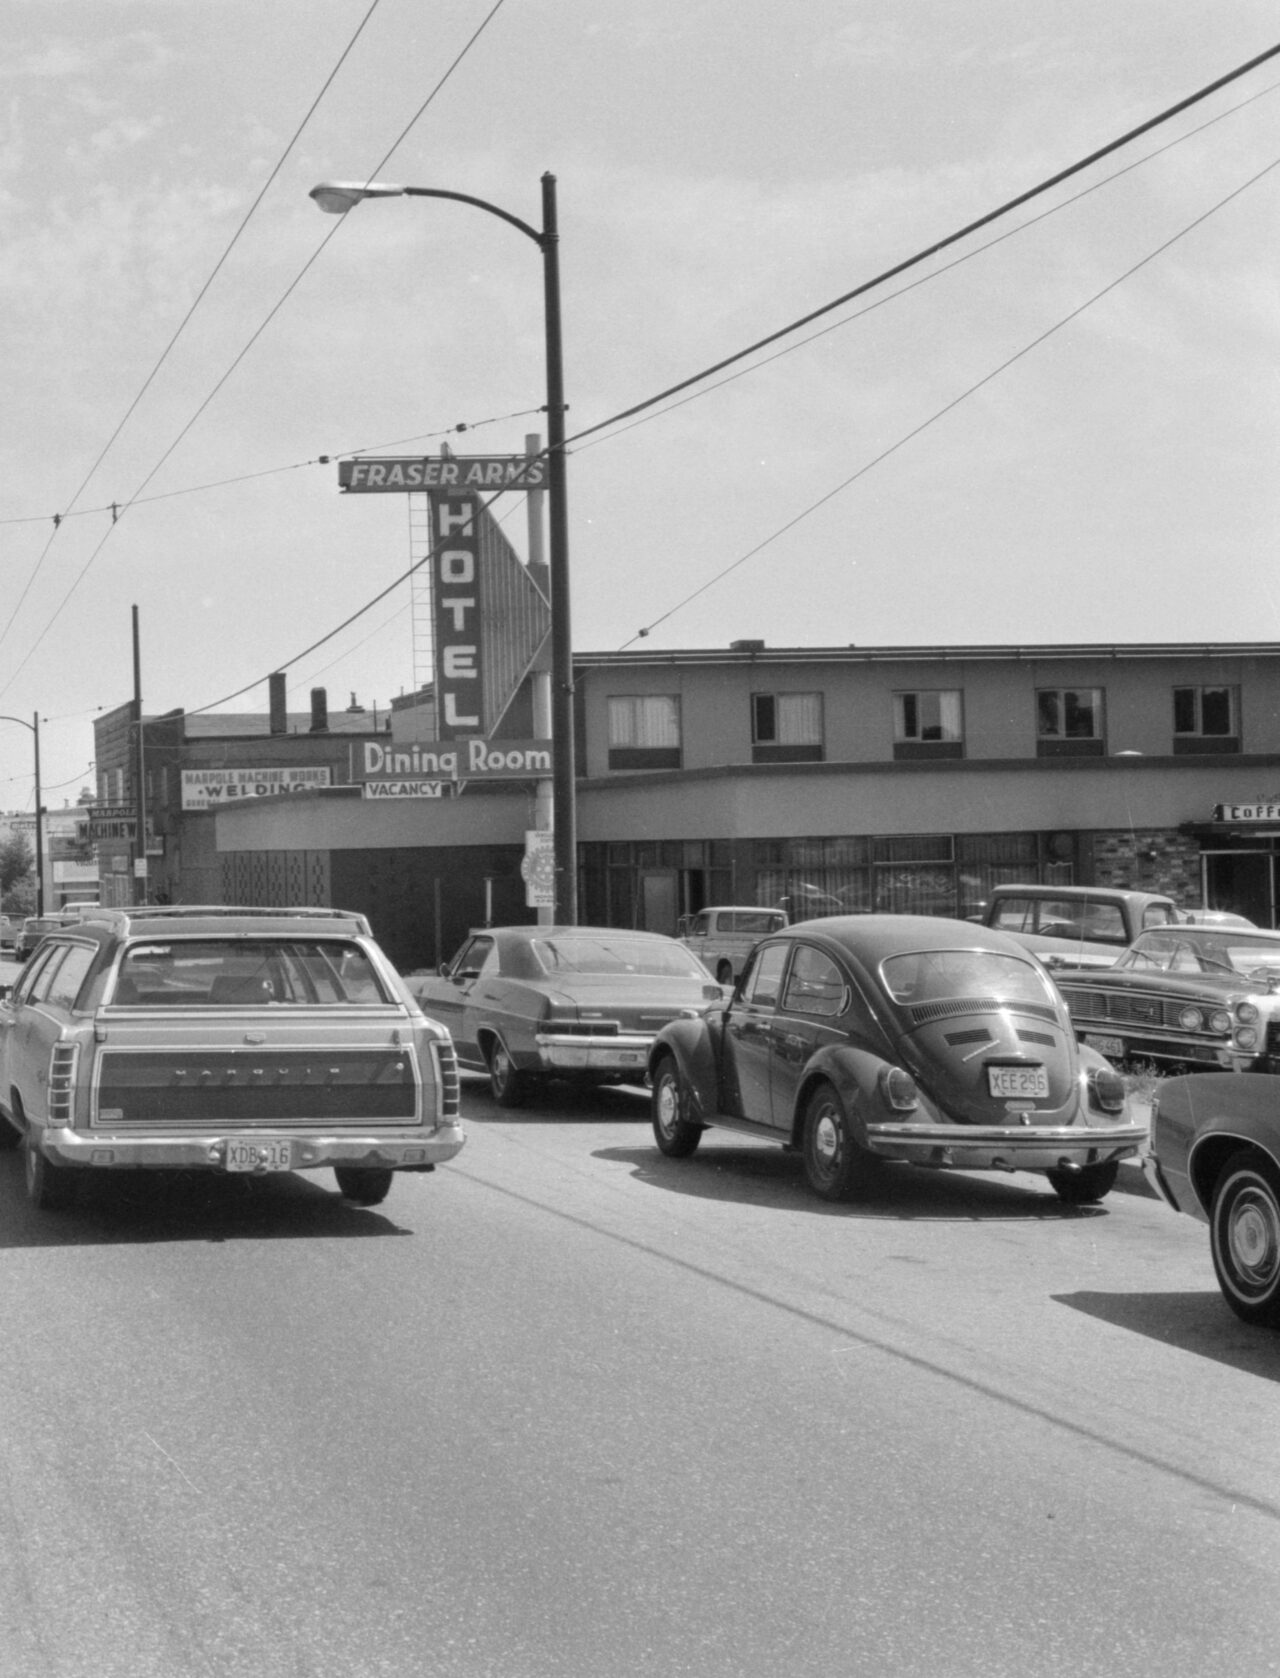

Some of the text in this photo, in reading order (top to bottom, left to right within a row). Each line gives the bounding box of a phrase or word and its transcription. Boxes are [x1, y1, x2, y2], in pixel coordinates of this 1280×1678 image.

[350, 461, 544, 487] FRASER ARMS
[438, 502, 479, 727] HOTEL
[364, 739, 551, 779] Dining Room
[185, 770, 327, 784] MARPOLE MACHINE WORKS
[205, 783, 306, 797] WELDING
[369, 782, 439, 797] VACANCY
[90, 808, 137, 817] MARPOLE
[79, 822, 128, 840] MACHINE
[991, 1073, 1045, 1090] XEE 296
[229, 1146, 257, 1164] XDB
